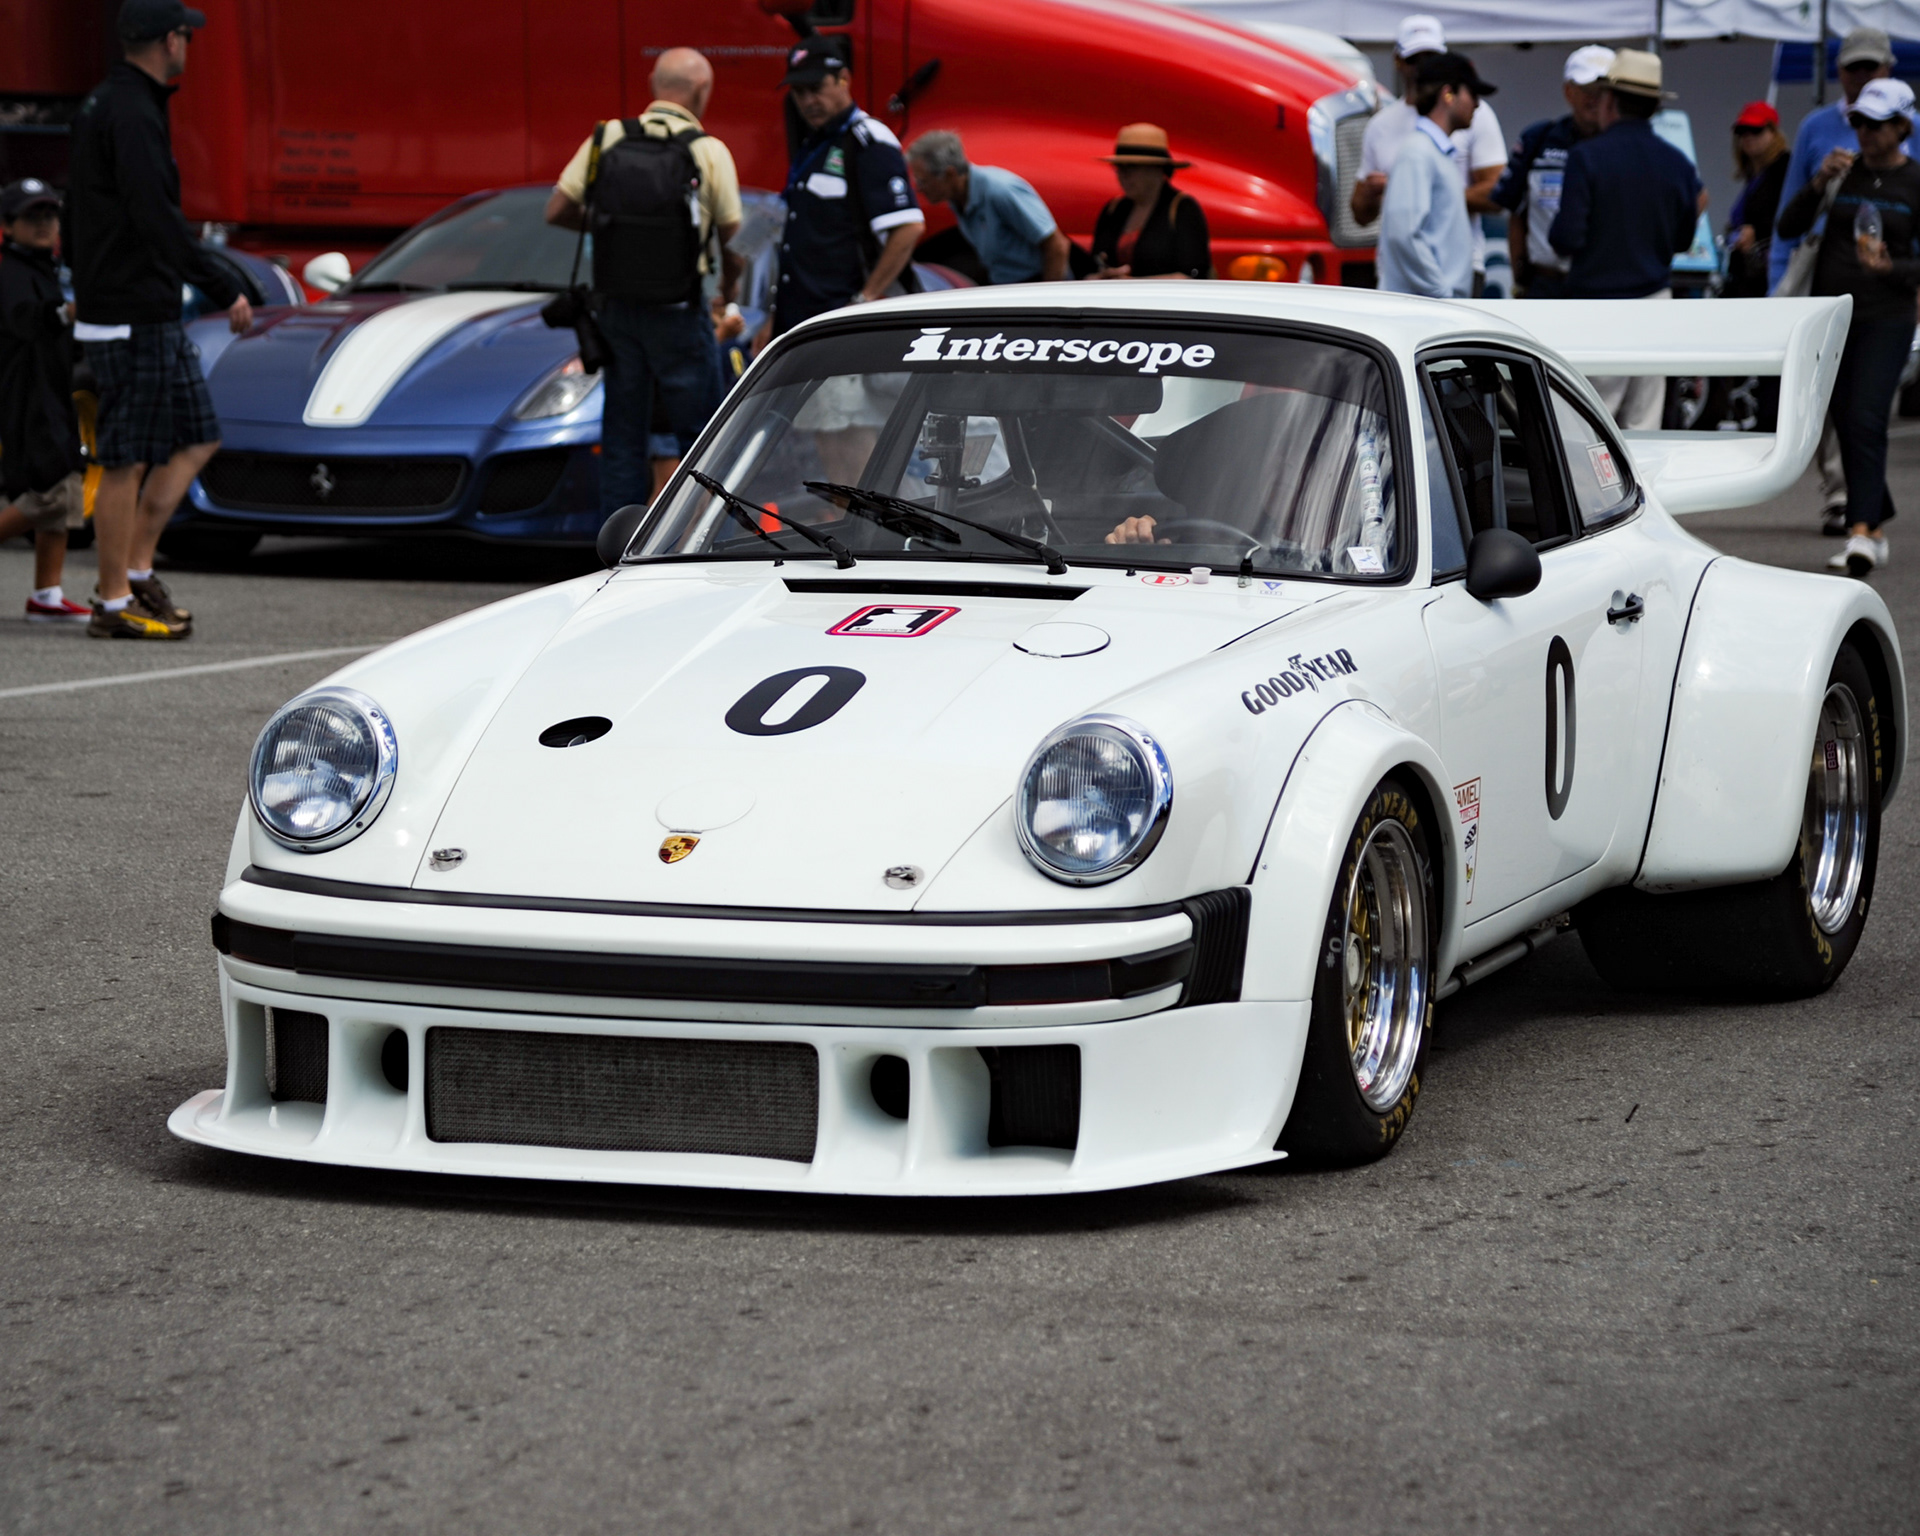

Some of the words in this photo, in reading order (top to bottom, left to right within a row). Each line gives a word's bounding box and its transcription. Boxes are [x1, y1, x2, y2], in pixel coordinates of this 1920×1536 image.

[903, 327, 1215, 374] interscope
[724, 665, 867, 737] 0
[1545, 634, 1577, 821] 0
[1825, 740, 1838, 769] BBS
[1456, 784, 1479, 808] AMEL
